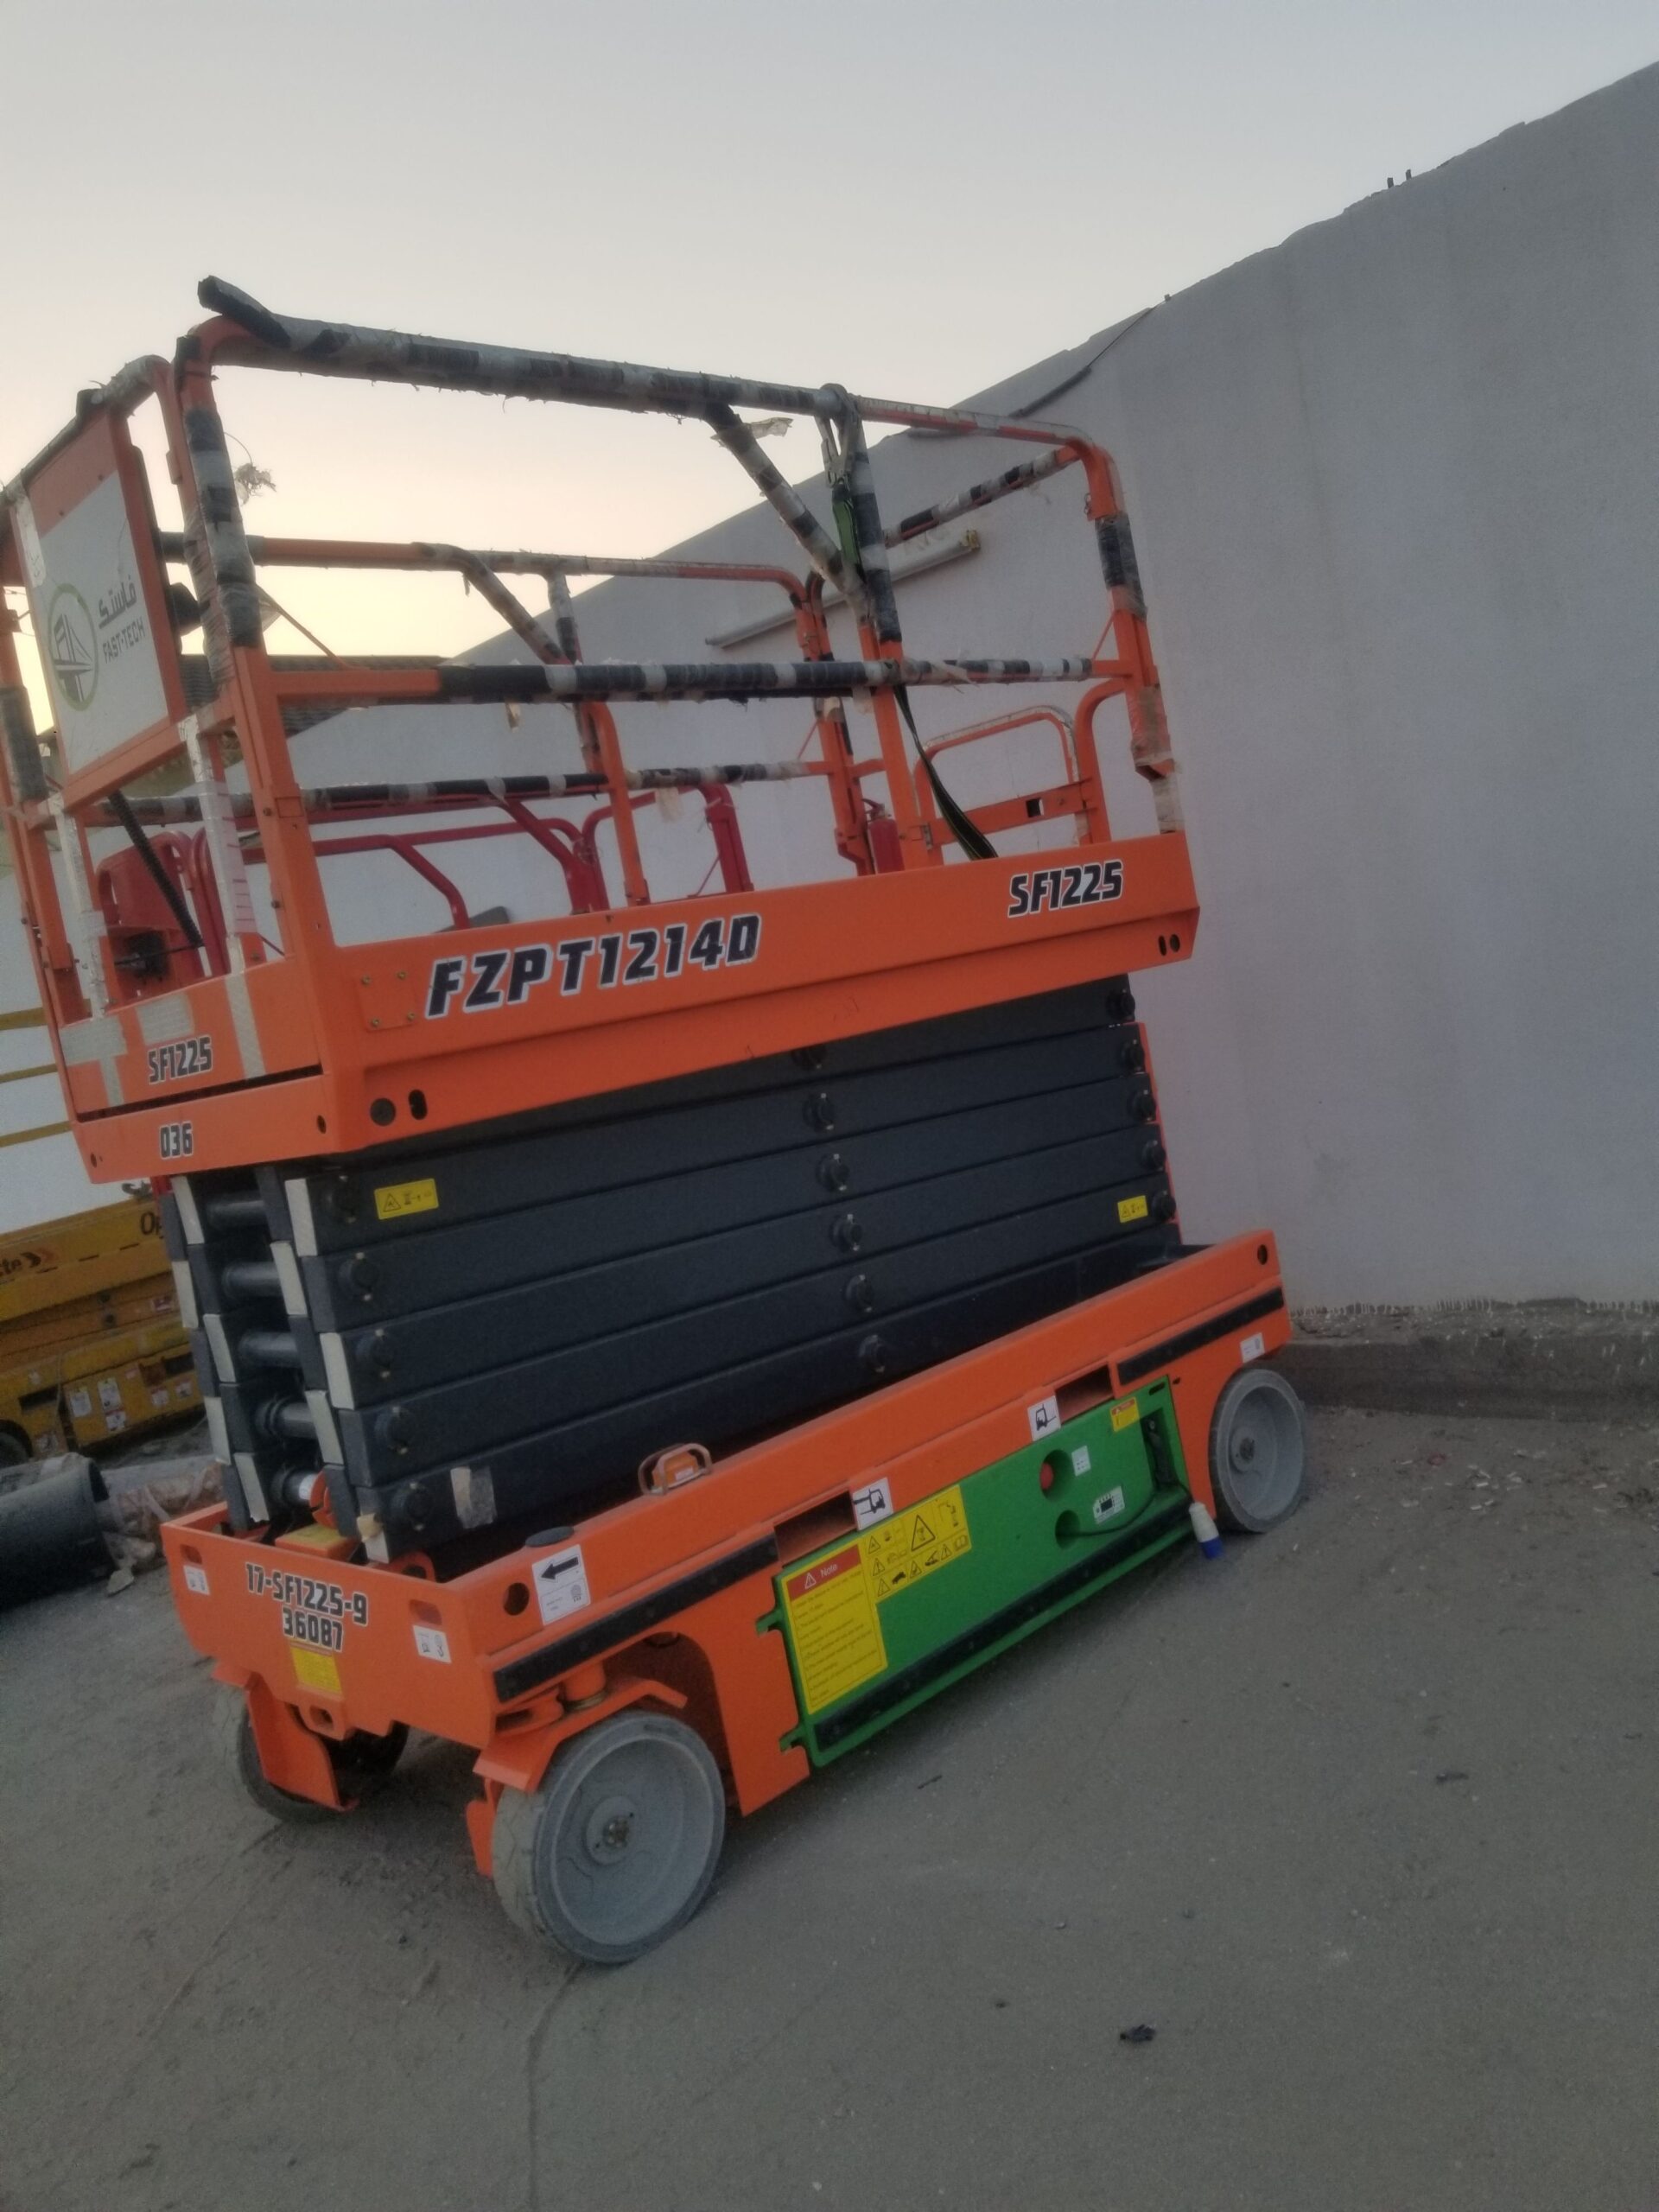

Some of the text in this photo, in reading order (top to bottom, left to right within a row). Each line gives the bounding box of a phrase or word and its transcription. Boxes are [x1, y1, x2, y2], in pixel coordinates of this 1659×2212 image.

[102, 616, 146, 664] FAST-TECH
[1007, 859, 1123, 918] SF1225
[147, 1034, 213, 1084] SF1225
[160, 1122, 194, 1160] 036
[245, 1561, 369, 1626] 17-SF1225-9
